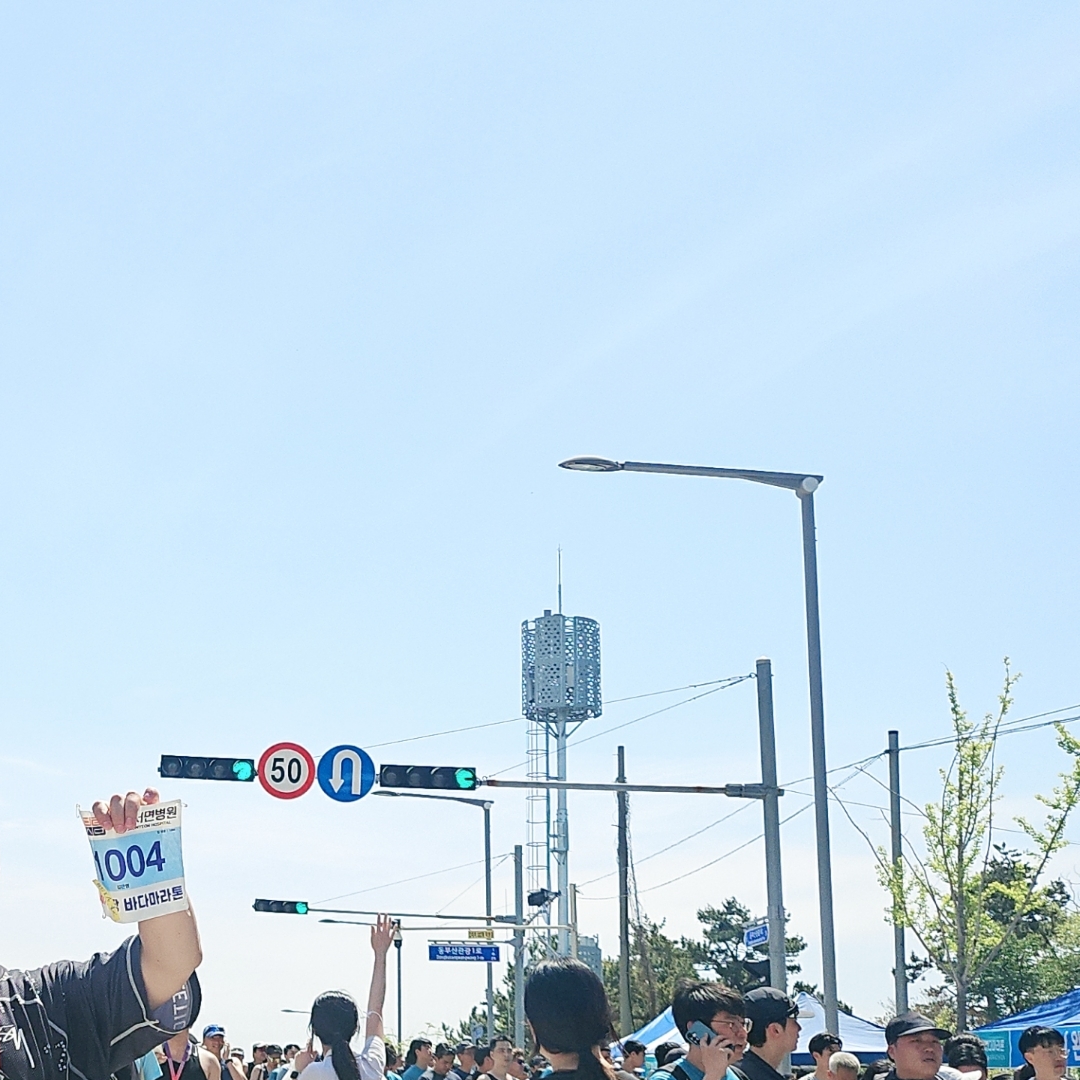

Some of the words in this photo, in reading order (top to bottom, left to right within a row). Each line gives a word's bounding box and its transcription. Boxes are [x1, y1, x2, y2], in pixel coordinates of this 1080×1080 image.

[271, 757, 302, 784] 50
[94, 840, 166, 882] 1004
[123, 885, 184, 912] 바다마라톤
